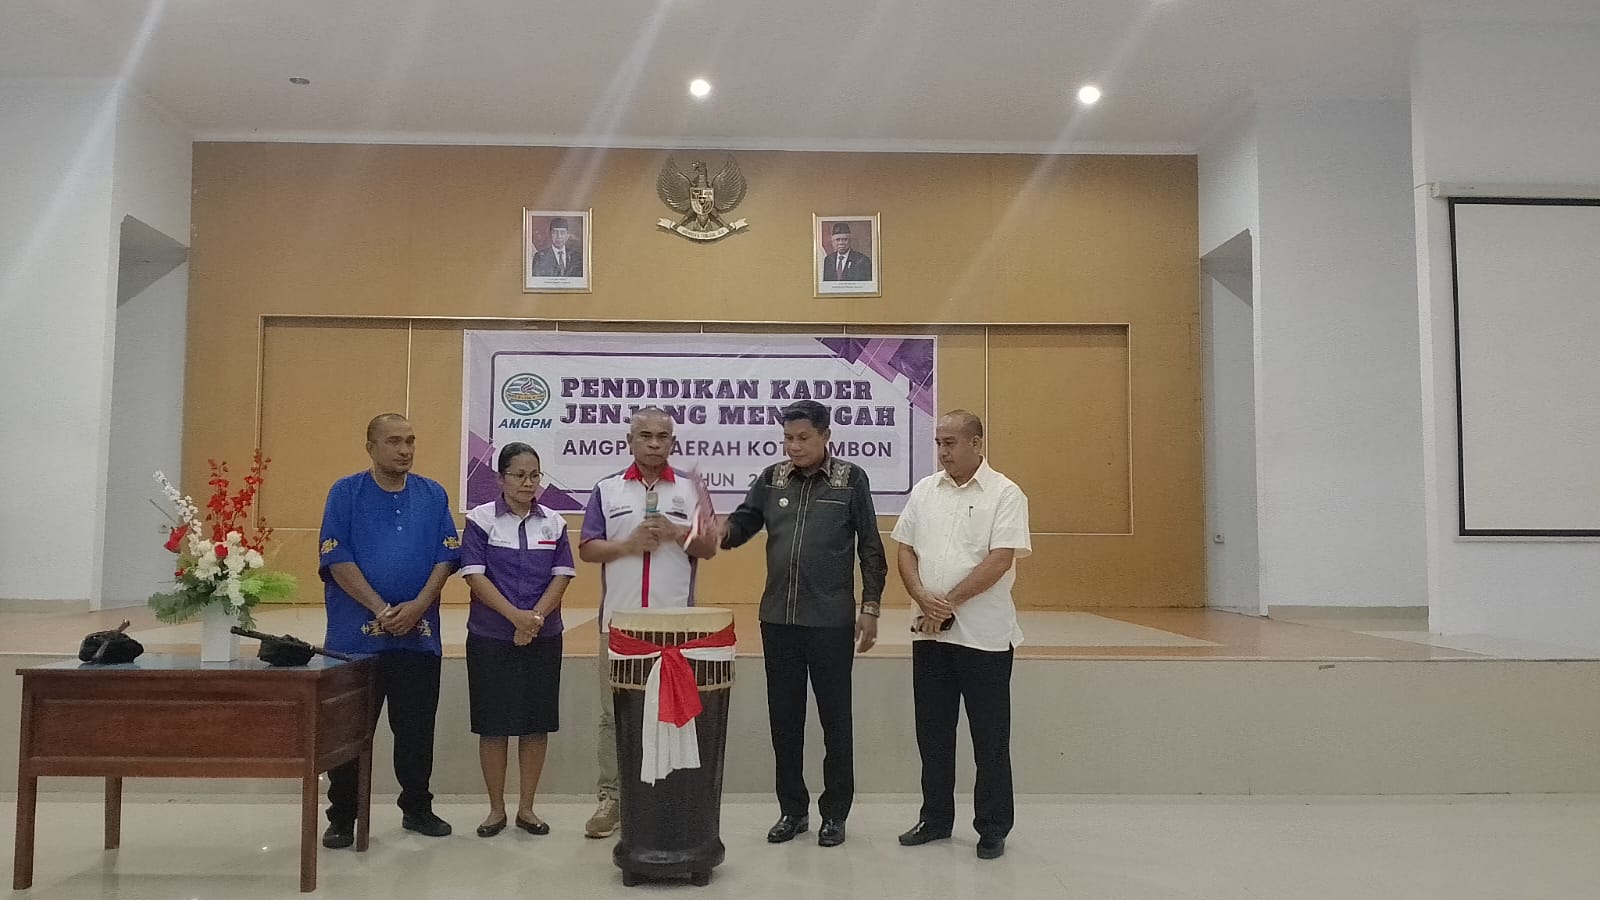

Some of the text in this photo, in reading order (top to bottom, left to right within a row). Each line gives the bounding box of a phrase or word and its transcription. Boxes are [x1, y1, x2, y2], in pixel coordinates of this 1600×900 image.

[560, 376, 872, 400] PENDIDIKAN KADER
[498, 418, 552, 429] AMGPM
[560, 403, 895, 426] JENJNG MENGAH
[562, 439, 892, 457] AMGP AERAH KOT MBON
[700, 472, 734, 487] HUN
